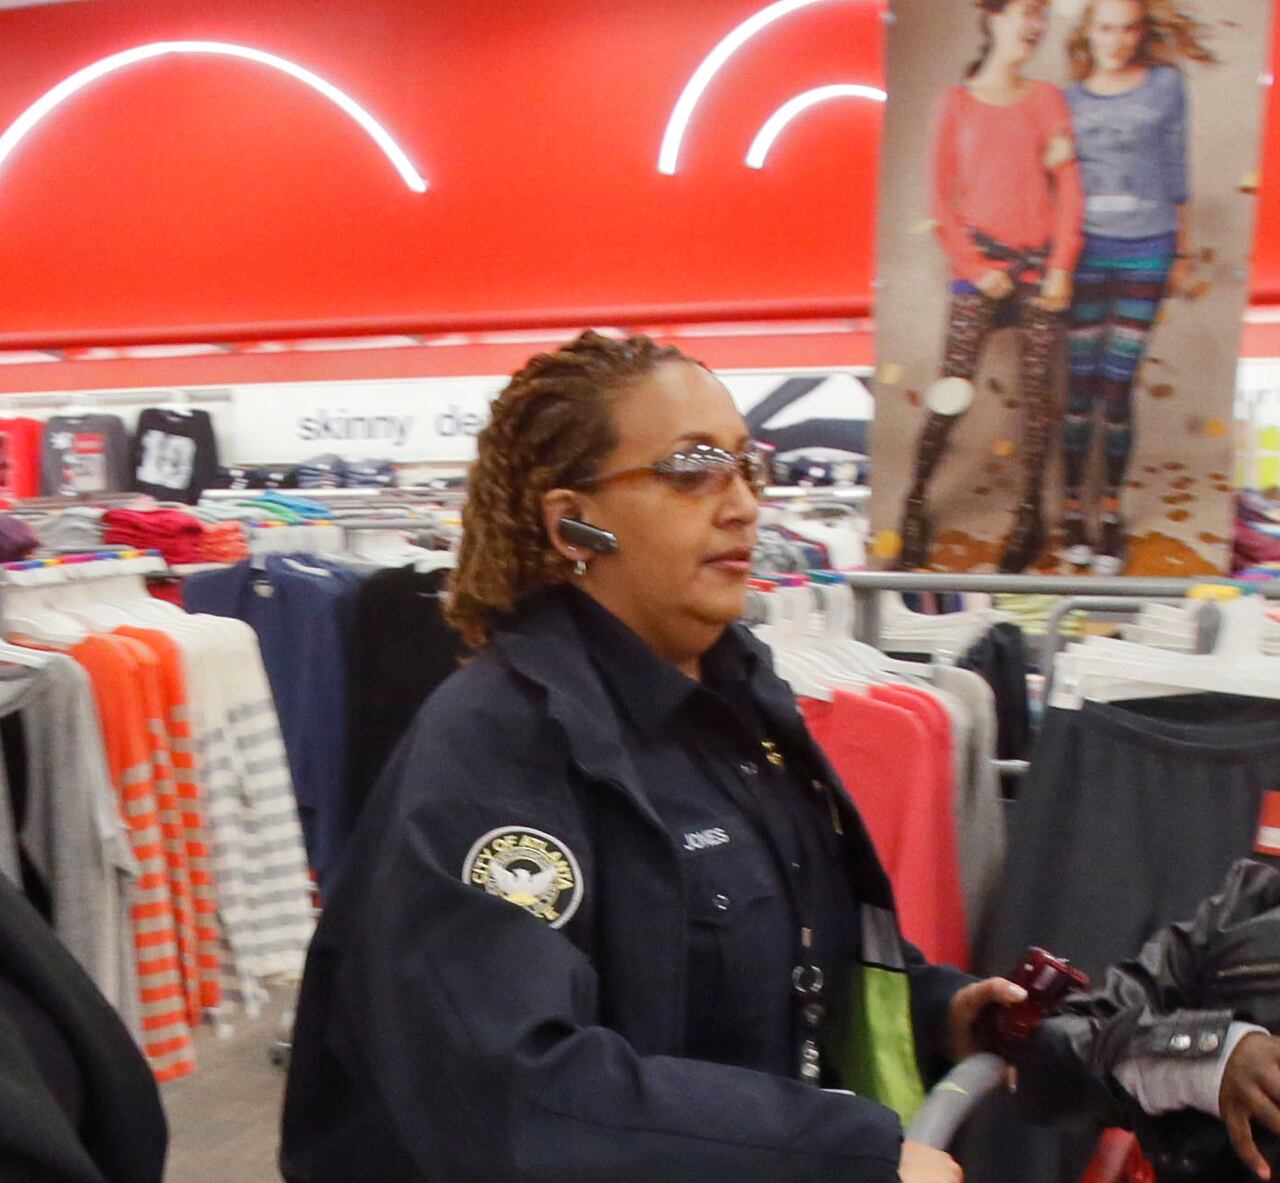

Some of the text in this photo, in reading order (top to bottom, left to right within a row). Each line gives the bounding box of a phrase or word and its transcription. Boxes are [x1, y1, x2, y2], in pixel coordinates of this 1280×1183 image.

[296, 407, 416, 447] skinny
[471, 848, 494, 884] CITY
[491, 834, 519, 852] OF
[683, 827, 730, 851] JONES
